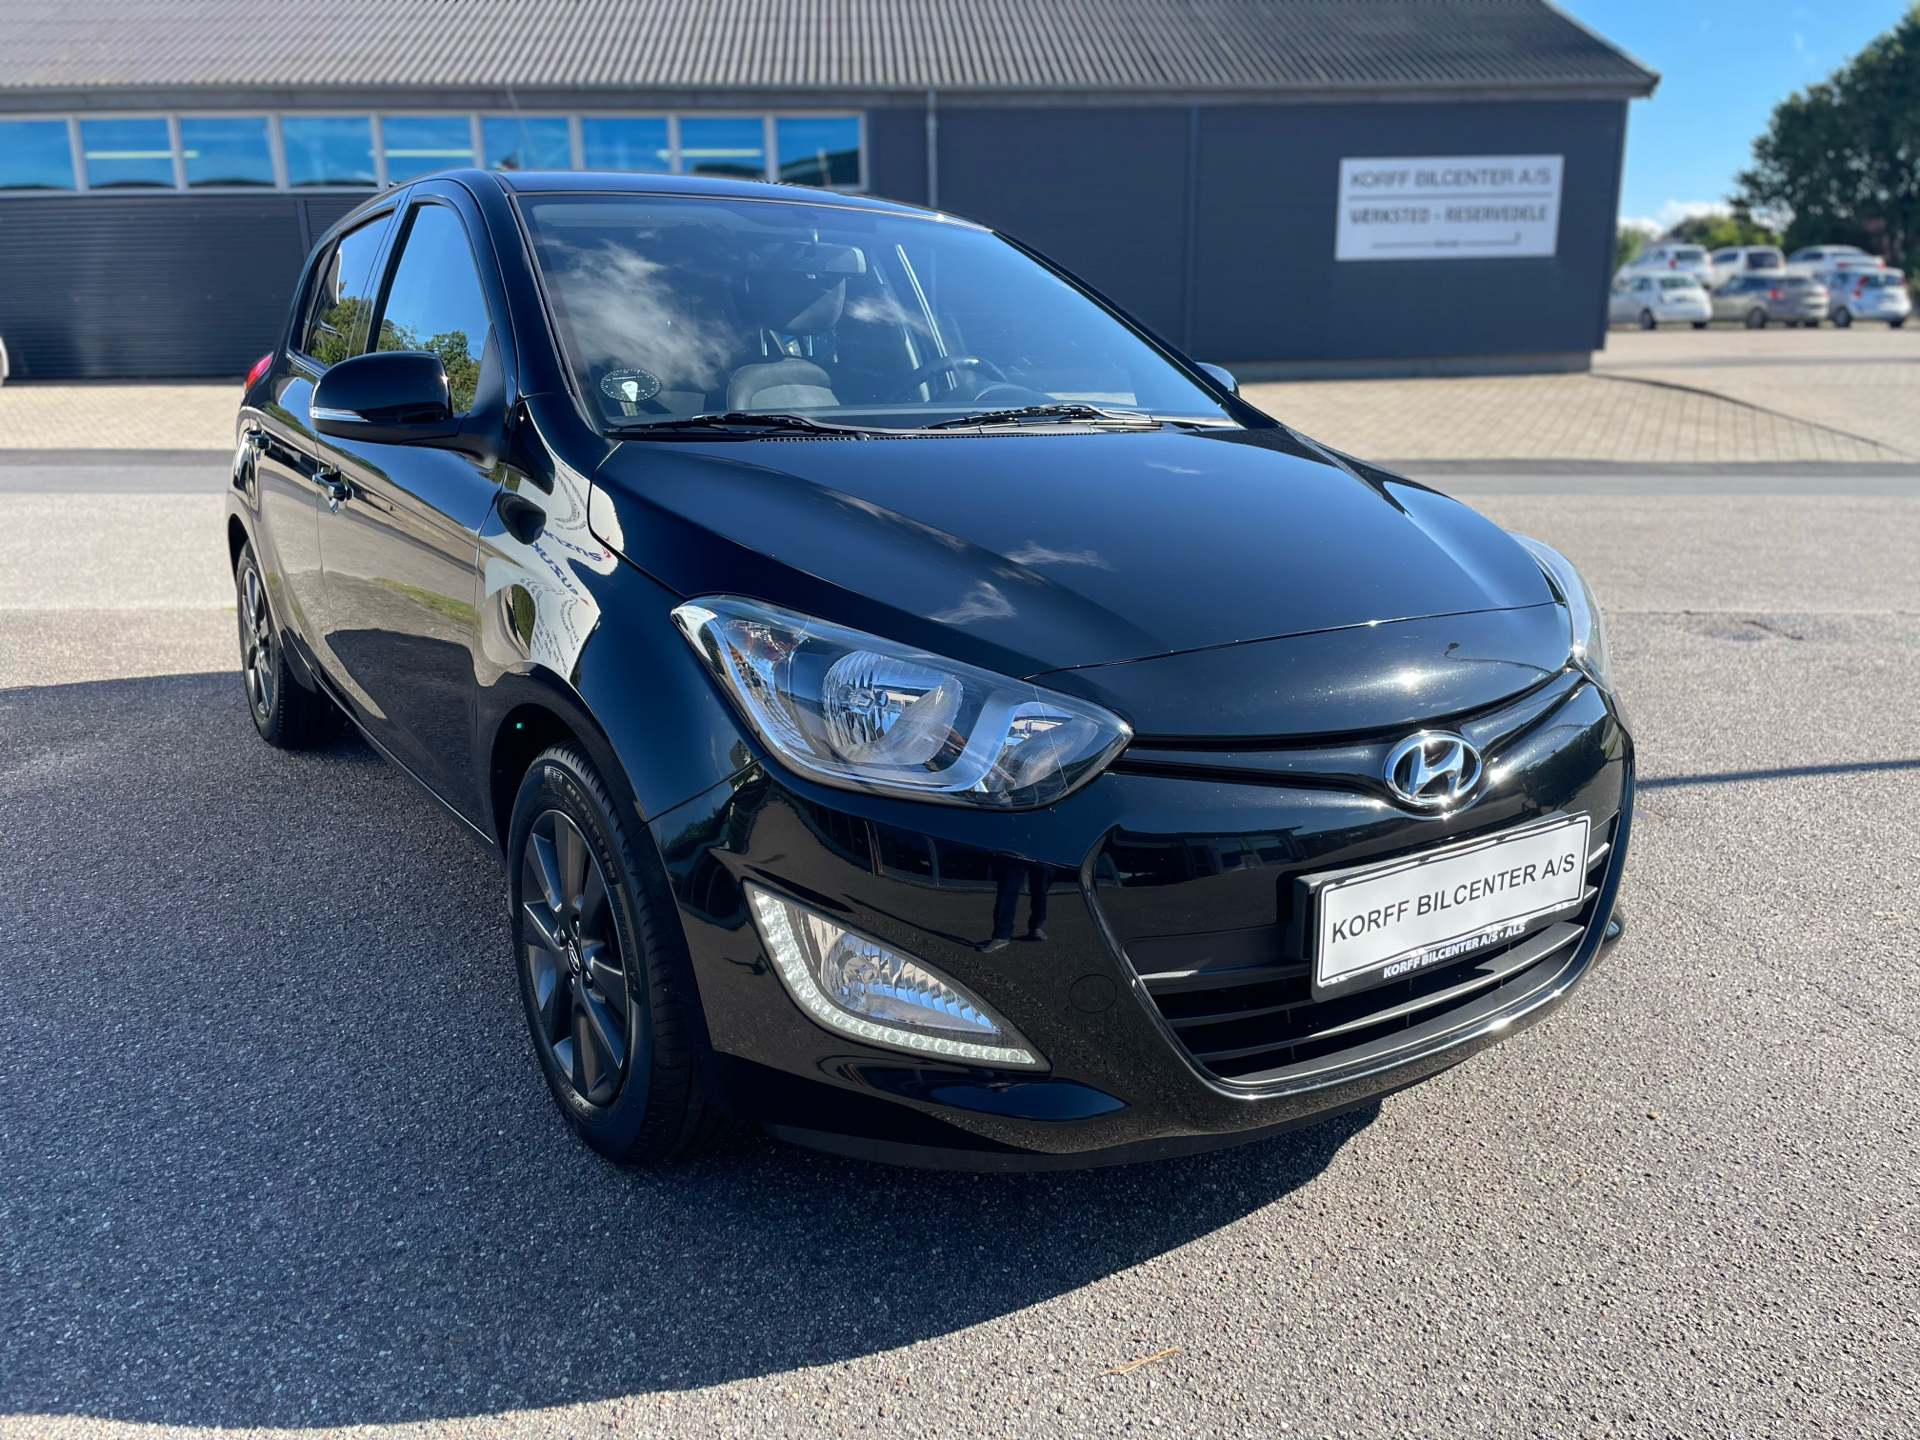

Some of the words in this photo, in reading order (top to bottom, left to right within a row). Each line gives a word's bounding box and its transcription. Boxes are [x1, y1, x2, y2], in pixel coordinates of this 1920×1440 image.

[1351, 170, 1411, 188] KORFF
[1414, 168, 1514, 187] BILCENTER
[1518, 167, 1551, 185] A/S
[1444, 204, 1547, 223] RESERVEDELE
[566, 783, 616, 879] MICHELIN
[1332, 900, 1410, 943] KORFF
[1416, 864, 1537, 917] BILCENTER
[1541, 853, 1576, 880] A/S
[1383, 956, 1420, 979] KORFF
[1421, 938, 1480, 966] BILCENTER
[1480, 931, 1499, 946] A/S
[1504, 922, 1526, 938] ALS
